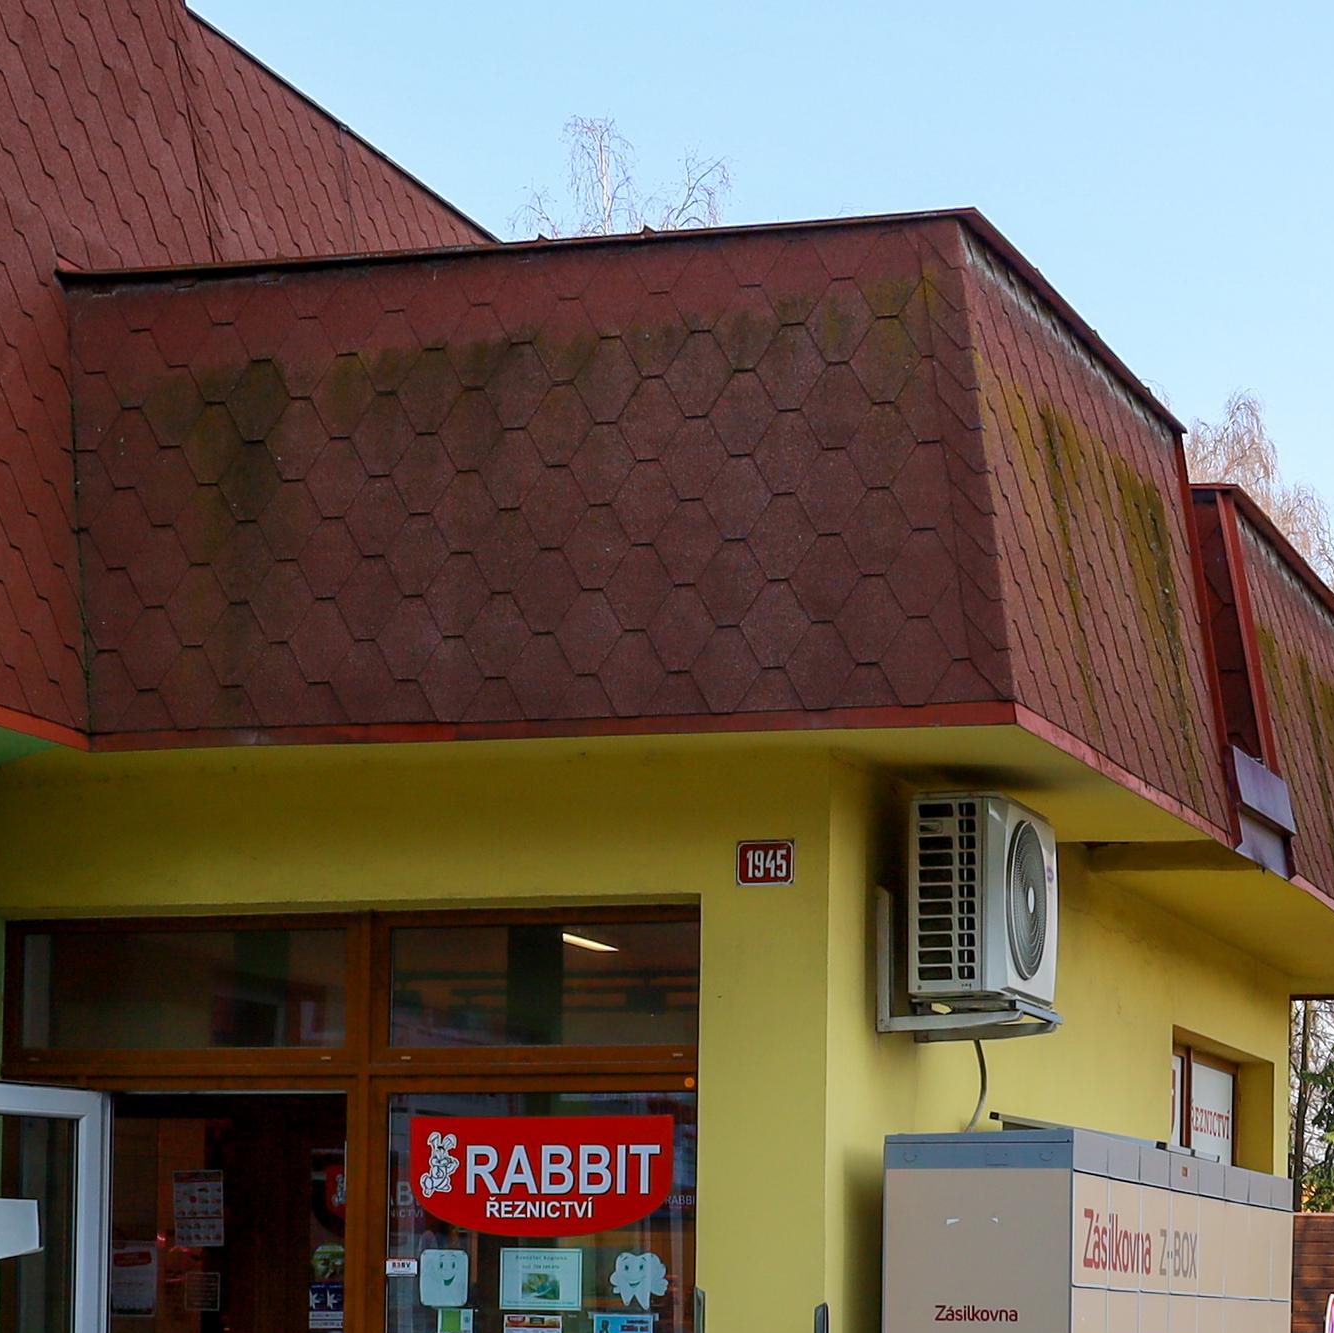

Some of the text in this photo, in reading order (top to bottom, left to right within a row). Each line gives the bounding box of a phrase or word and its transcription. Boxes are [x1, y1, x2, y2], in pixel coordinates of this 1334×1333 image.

[747, 849, 787, 878] 1945
[466, 1144, 660, 1195] RABBIT
[486, 1196, 594, 1219] ŘEZNICTVÍ
[1083, 1208, 1152, 1275] Zásilkovna
[934, 1305, 1019, 1322] Zásilkovna
